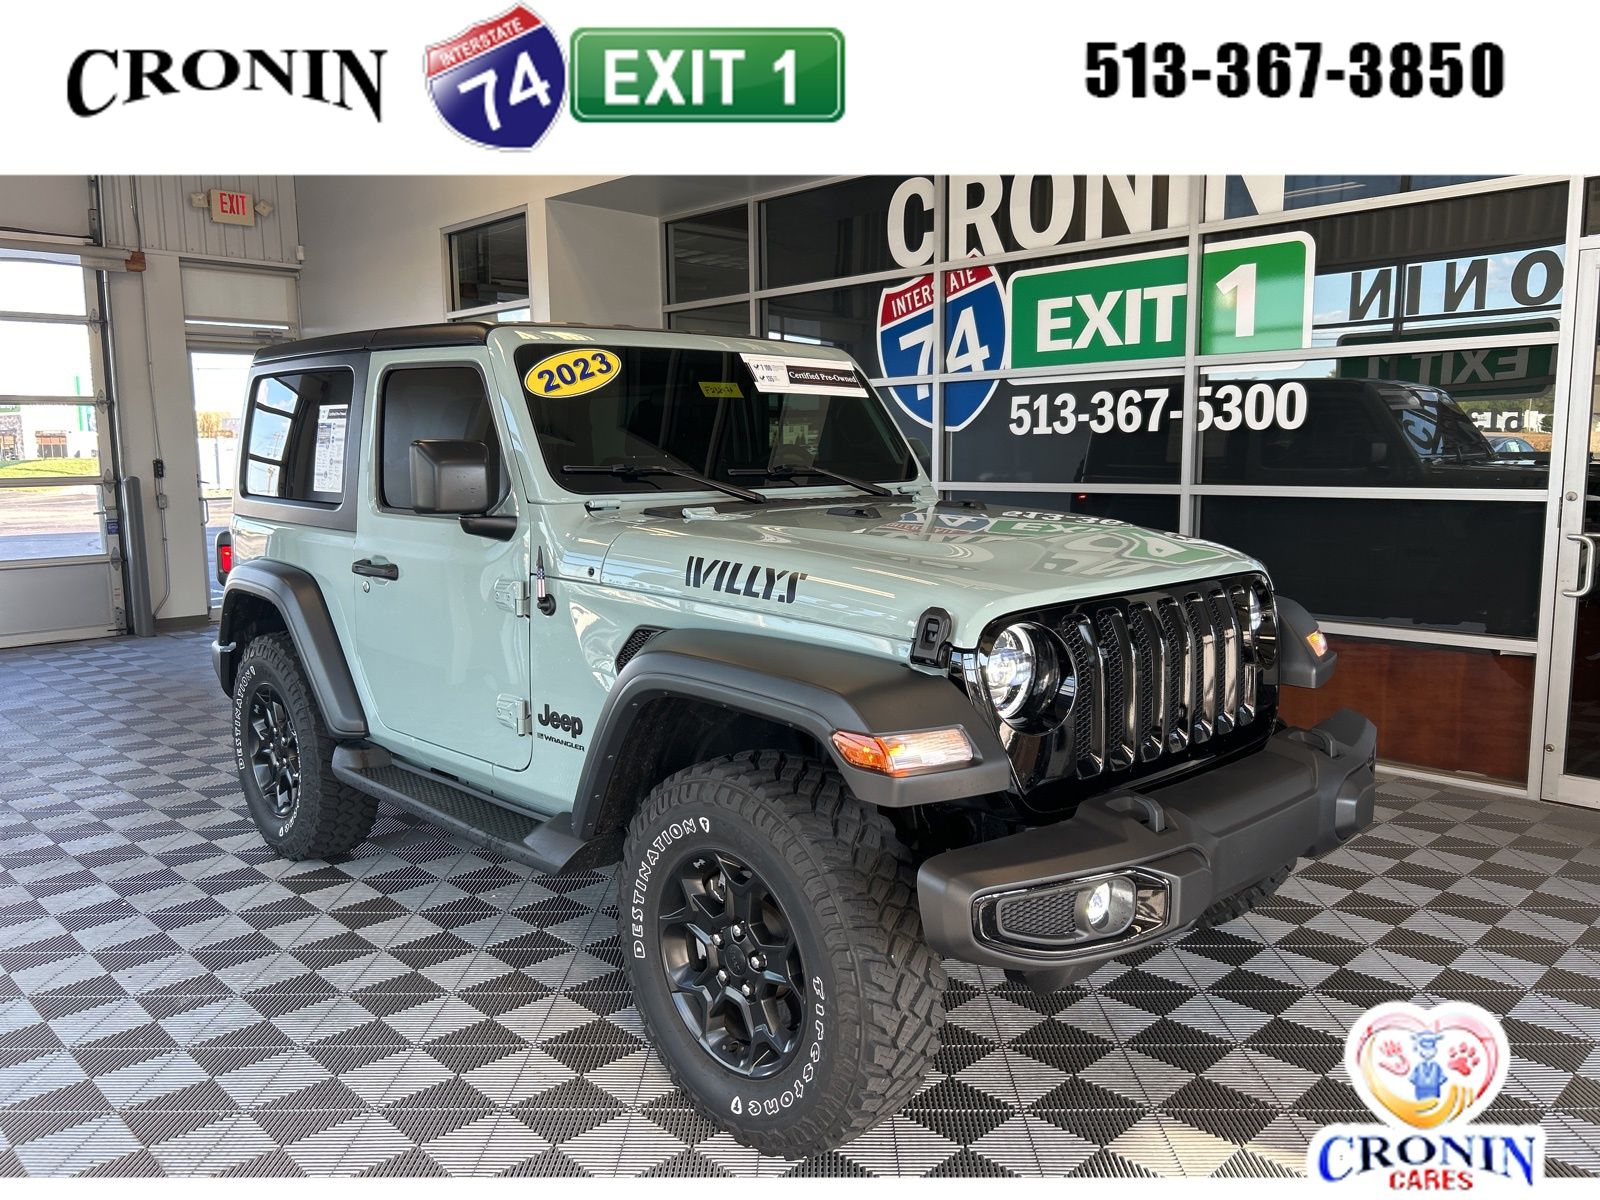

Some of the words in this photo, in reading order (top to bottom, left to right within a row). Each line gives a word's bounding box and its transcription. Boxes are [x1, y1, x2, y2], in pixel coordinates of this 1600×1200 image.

[219, 192, 247, 216] EXIT
[887, 174, 1286, 268] CRONIN
[891, 267, 977, 318] INTERSATE
[1037, 283, 1188, 353] EXIT
[1215, 263, 1257, 338] 1
[537, 353, 613, 394] 2023
[788, 371, 820, 381] Certified
[821, 373, 858, 383] Pre-Owned
[898, 306, 990, 400] 74
[1009, 382, 1308, 435] 513-367-5300
[685, 555, 808, 604] WILLYS
[235, 670, 253, 770] DESTINATION
[538, 703, 583, 739] Jeep
[544, 733, 585, 752] WRANGLER
[633, 817, 697, 958] DESTINATION
[748, 976, 825, 1118] Firestone
